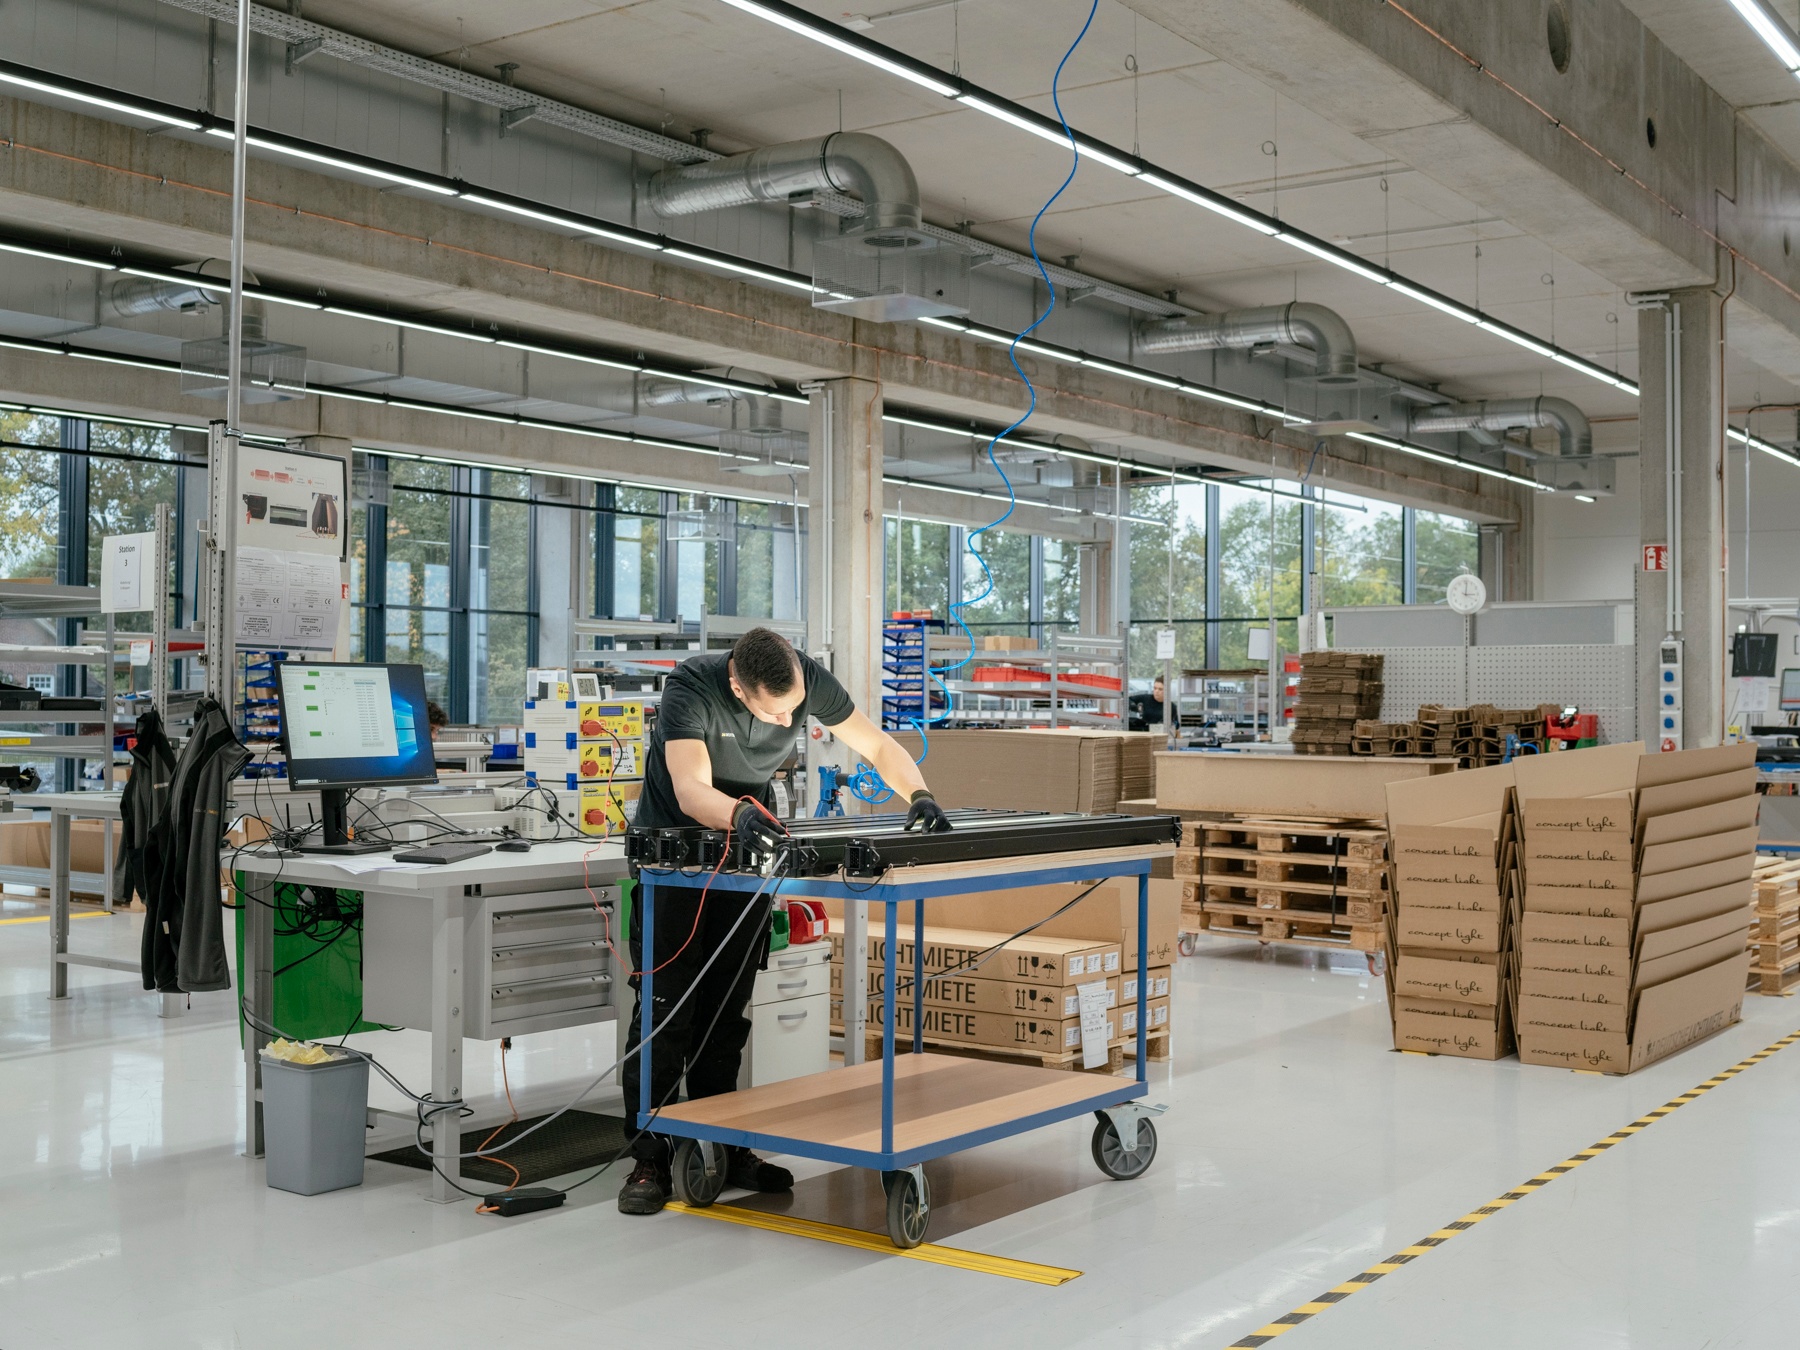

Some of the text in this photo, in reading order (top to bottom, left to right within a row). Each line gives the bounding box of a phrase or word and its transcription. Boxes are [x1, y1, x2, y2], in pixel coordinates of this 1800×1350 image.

[119, 545, 136, 554] Station
[124, 559, 128, 567] 3
[1535, 816, 1617, 832] concept light
[1408, 929, 1484, 944] concept light
[867, 941, 979, 971] IHTMIETE
[1131, 943, 1171, 960] copt light
[866, 972, 976, 1004] ICTMIETE
[1406, 979, 1483, 996] concept light
[866, 1004, 976, 1036] ICTMIETE
[1405, 1035, 1481, 1052] concept light
[1531, 1048, 1613, 1066] concept light
